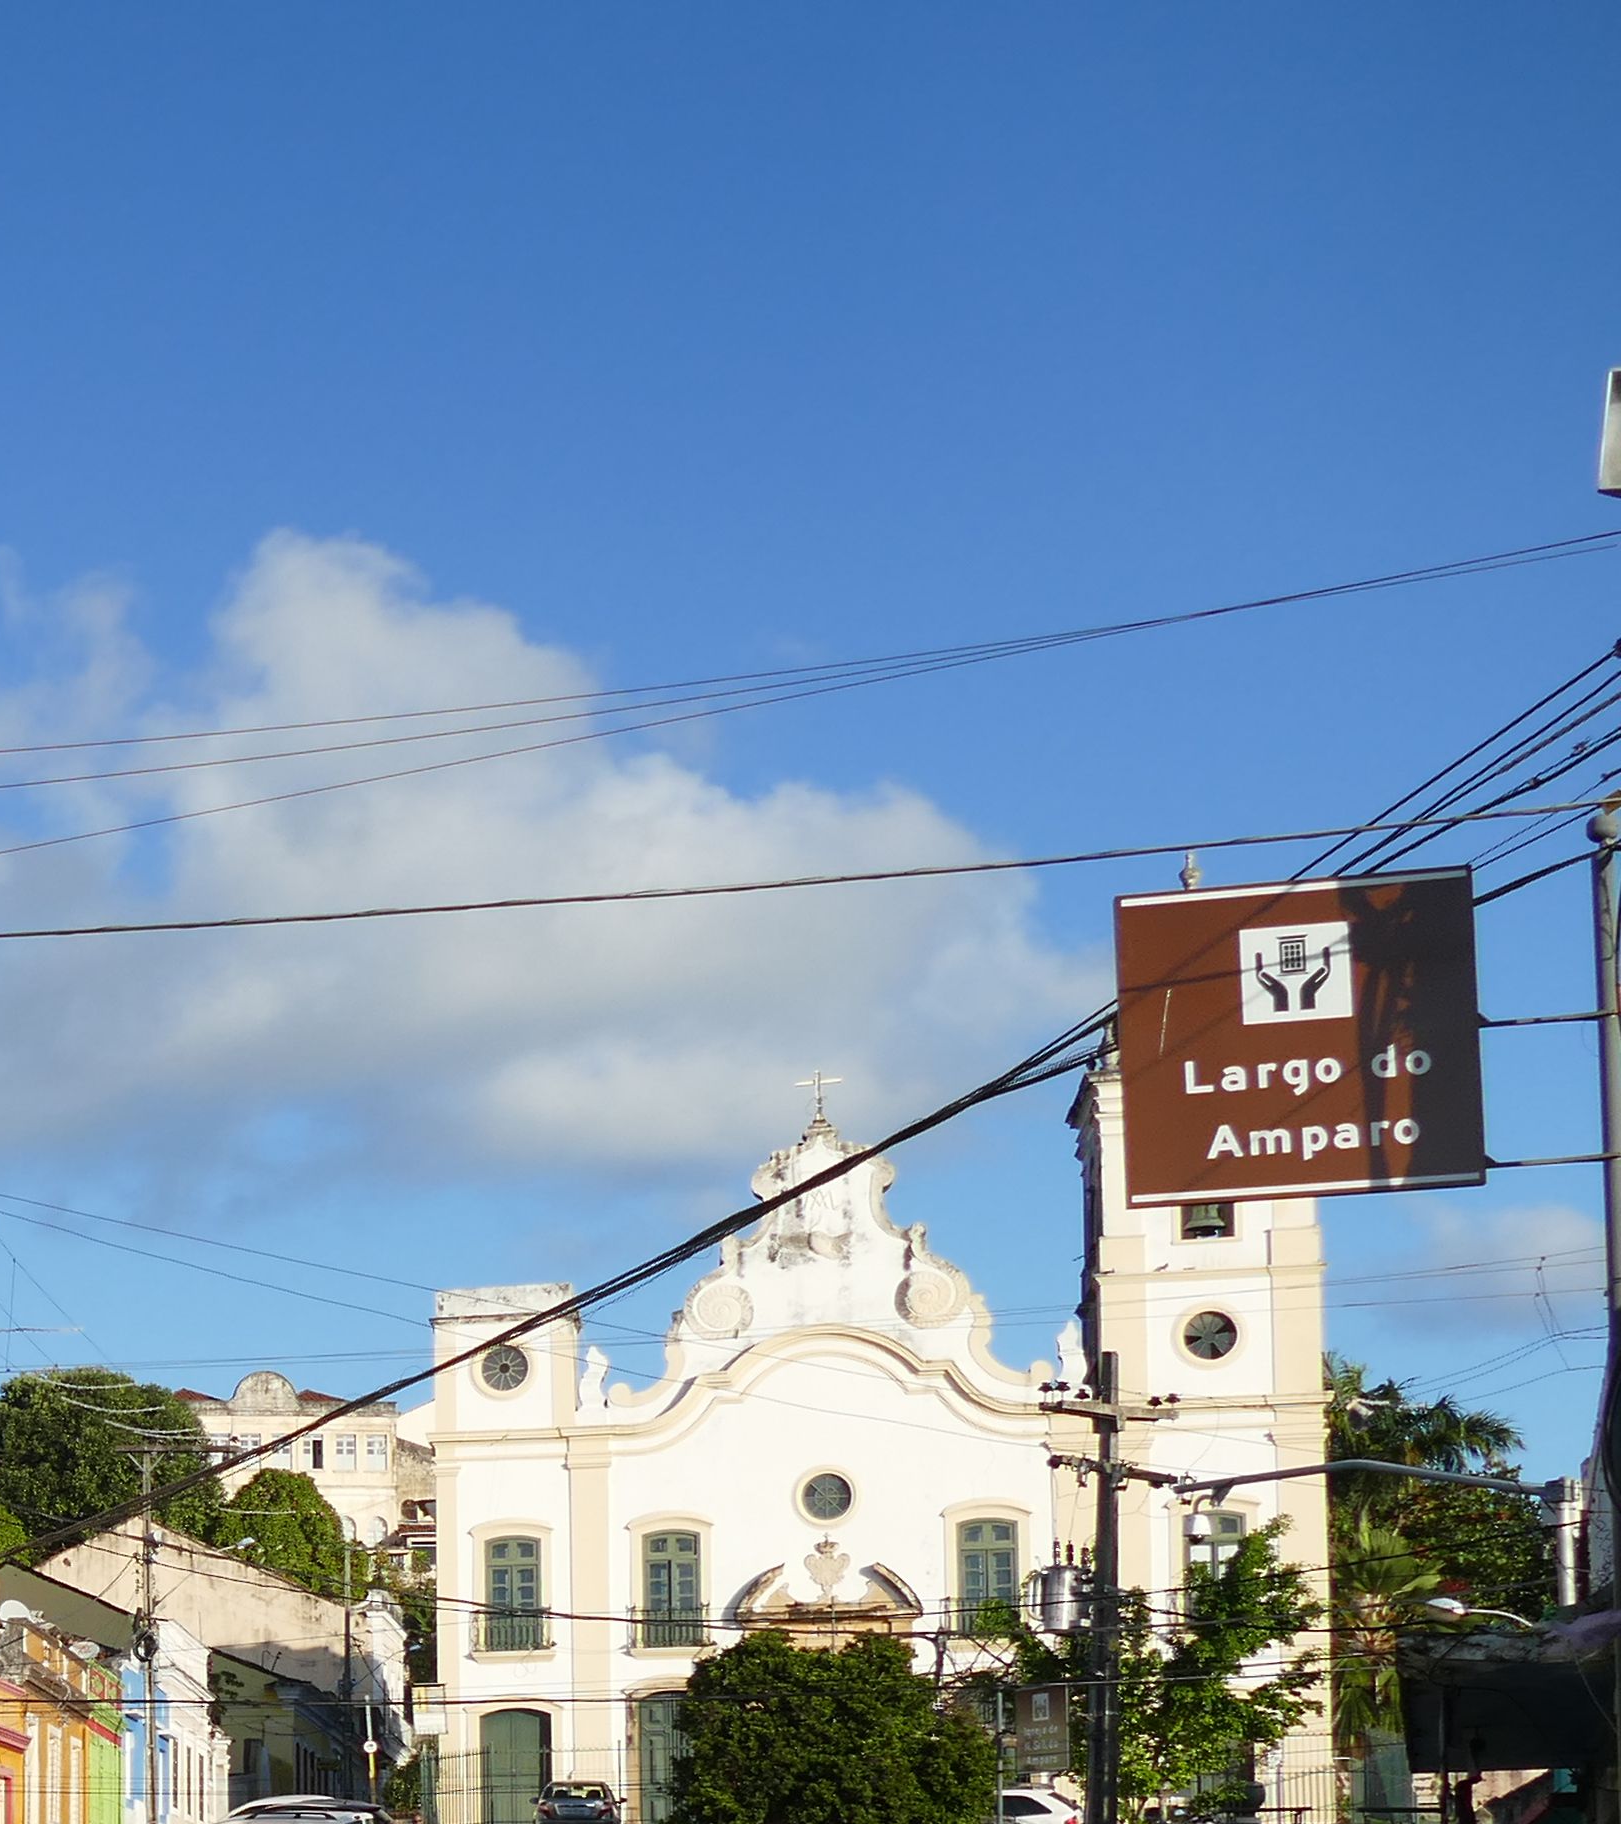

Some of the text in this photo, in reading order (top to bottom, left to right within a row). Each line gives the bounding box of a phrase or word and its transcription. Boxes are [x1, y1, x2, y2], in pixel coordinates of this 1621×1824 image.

[1184, 1043, 1432, 1096] Largo do
[1206, 1117, 1421, 1161] Amparo
